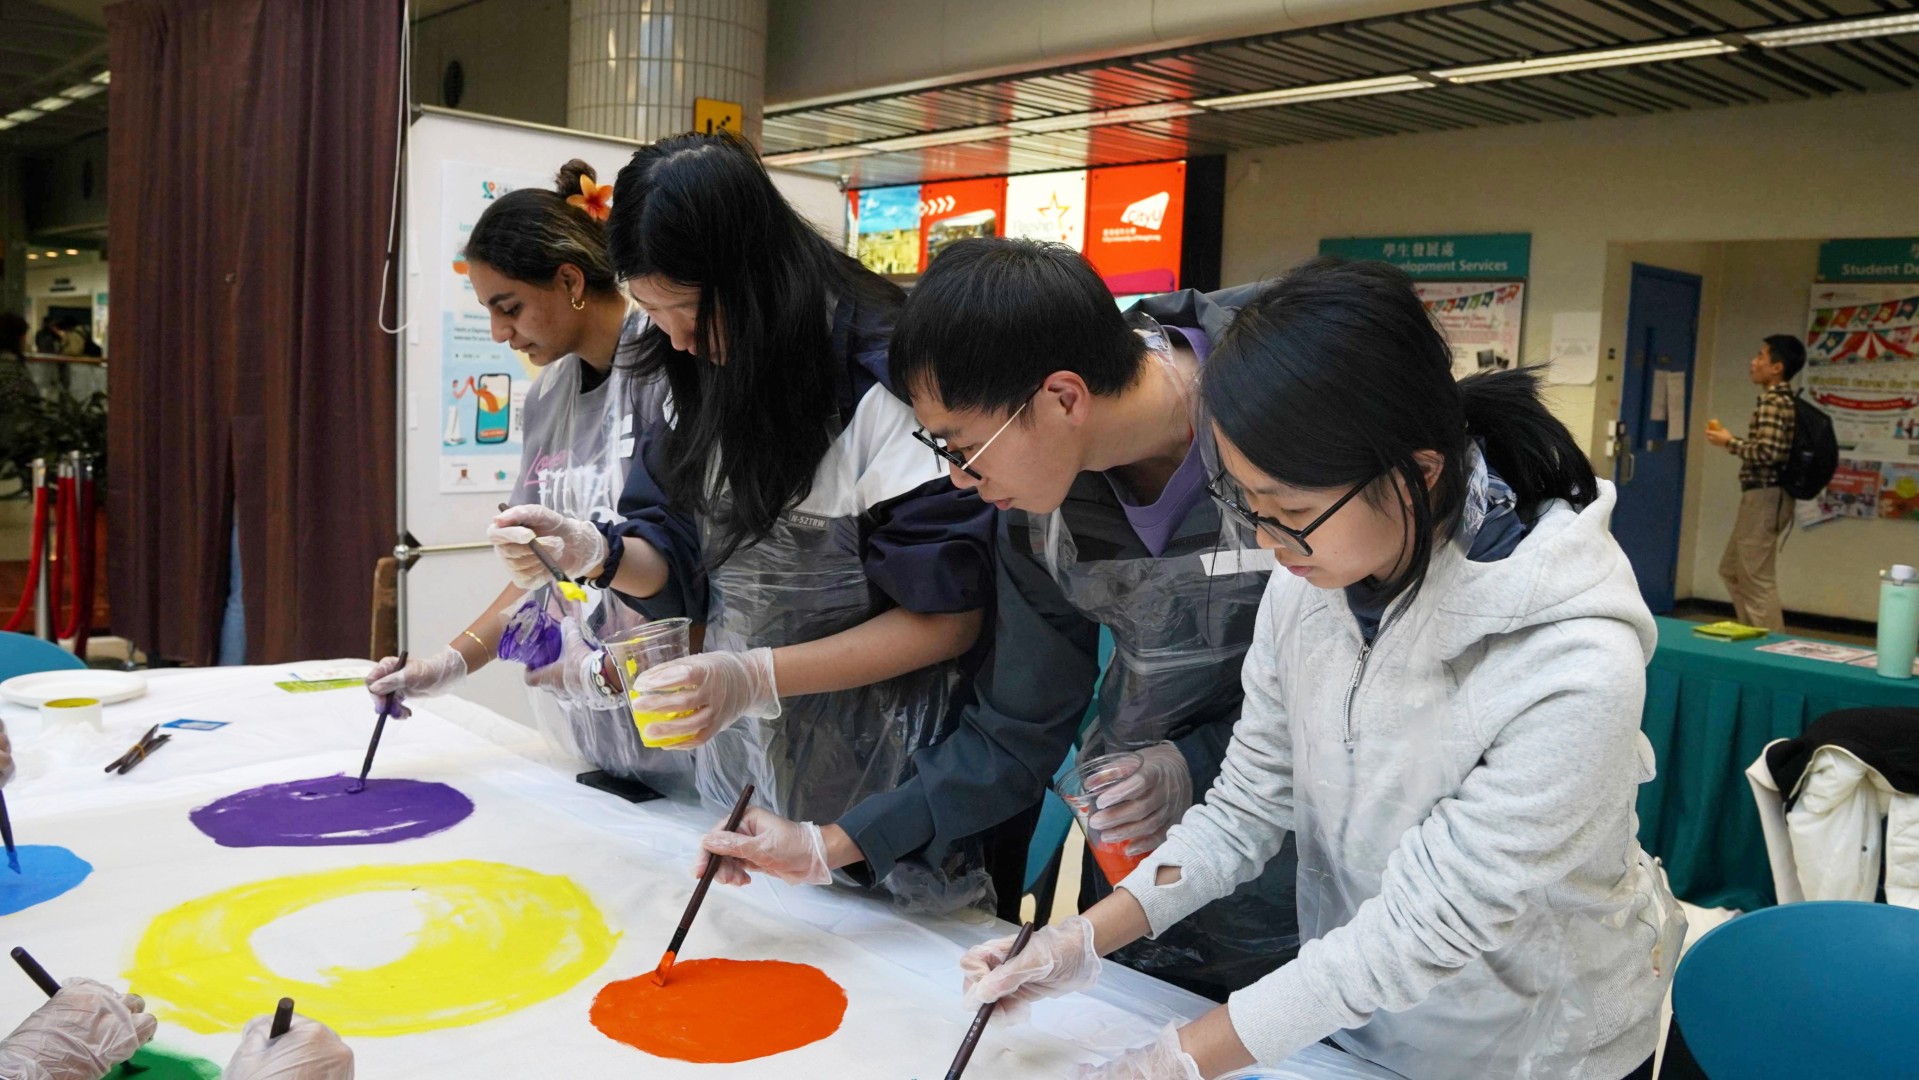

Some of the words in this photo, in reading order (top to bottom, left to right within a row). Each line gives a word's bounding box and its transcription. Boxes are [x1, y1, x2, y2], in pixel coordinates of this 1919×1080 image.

[1128, 209, 1161, 226] CityU
[1460, 259, 1508, 272] Services
[1841, 263, 1899, 275] Student
